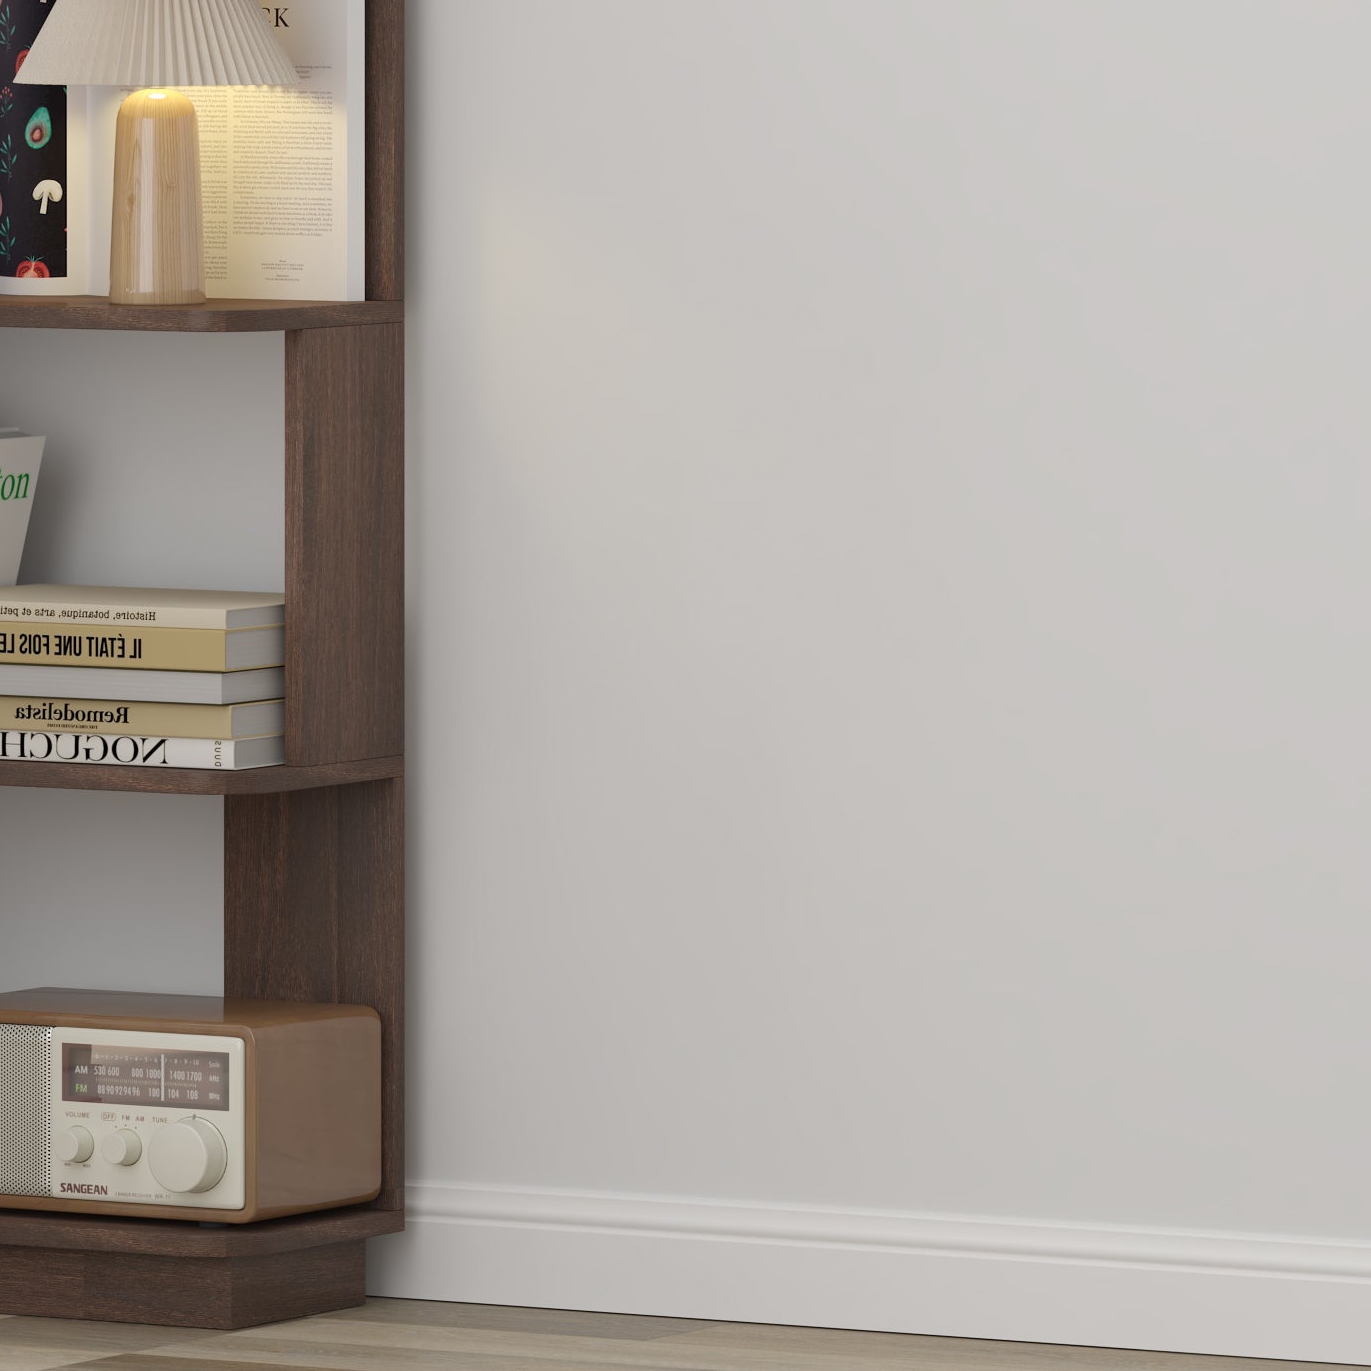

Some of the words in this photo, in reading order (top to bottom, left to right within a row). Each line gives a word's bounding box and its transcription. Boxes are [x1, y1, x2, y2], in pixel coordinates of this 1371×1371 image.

[74, 1065, 88, 1075] AM
[94, 1067, 106, 1076] 530
[107, 1068, 119, 1077] 600
[132, 1068, 143, 1078] 800
[146, 1069, 161, 1079] 1000
[169, 1070, 185, 1080] 1400
[186, 1071, 202, 1081] 1700
[75, 1084, 87, 1093] FM
[148, 1087, 160, 1098] 100
[168, 1089, 179, 1099] 104
[187, 1090, 198, 1100] 108
[65, 1111, 90, 1119] VOLUME
[60, 1182, 108, 1196] SANGEAN
